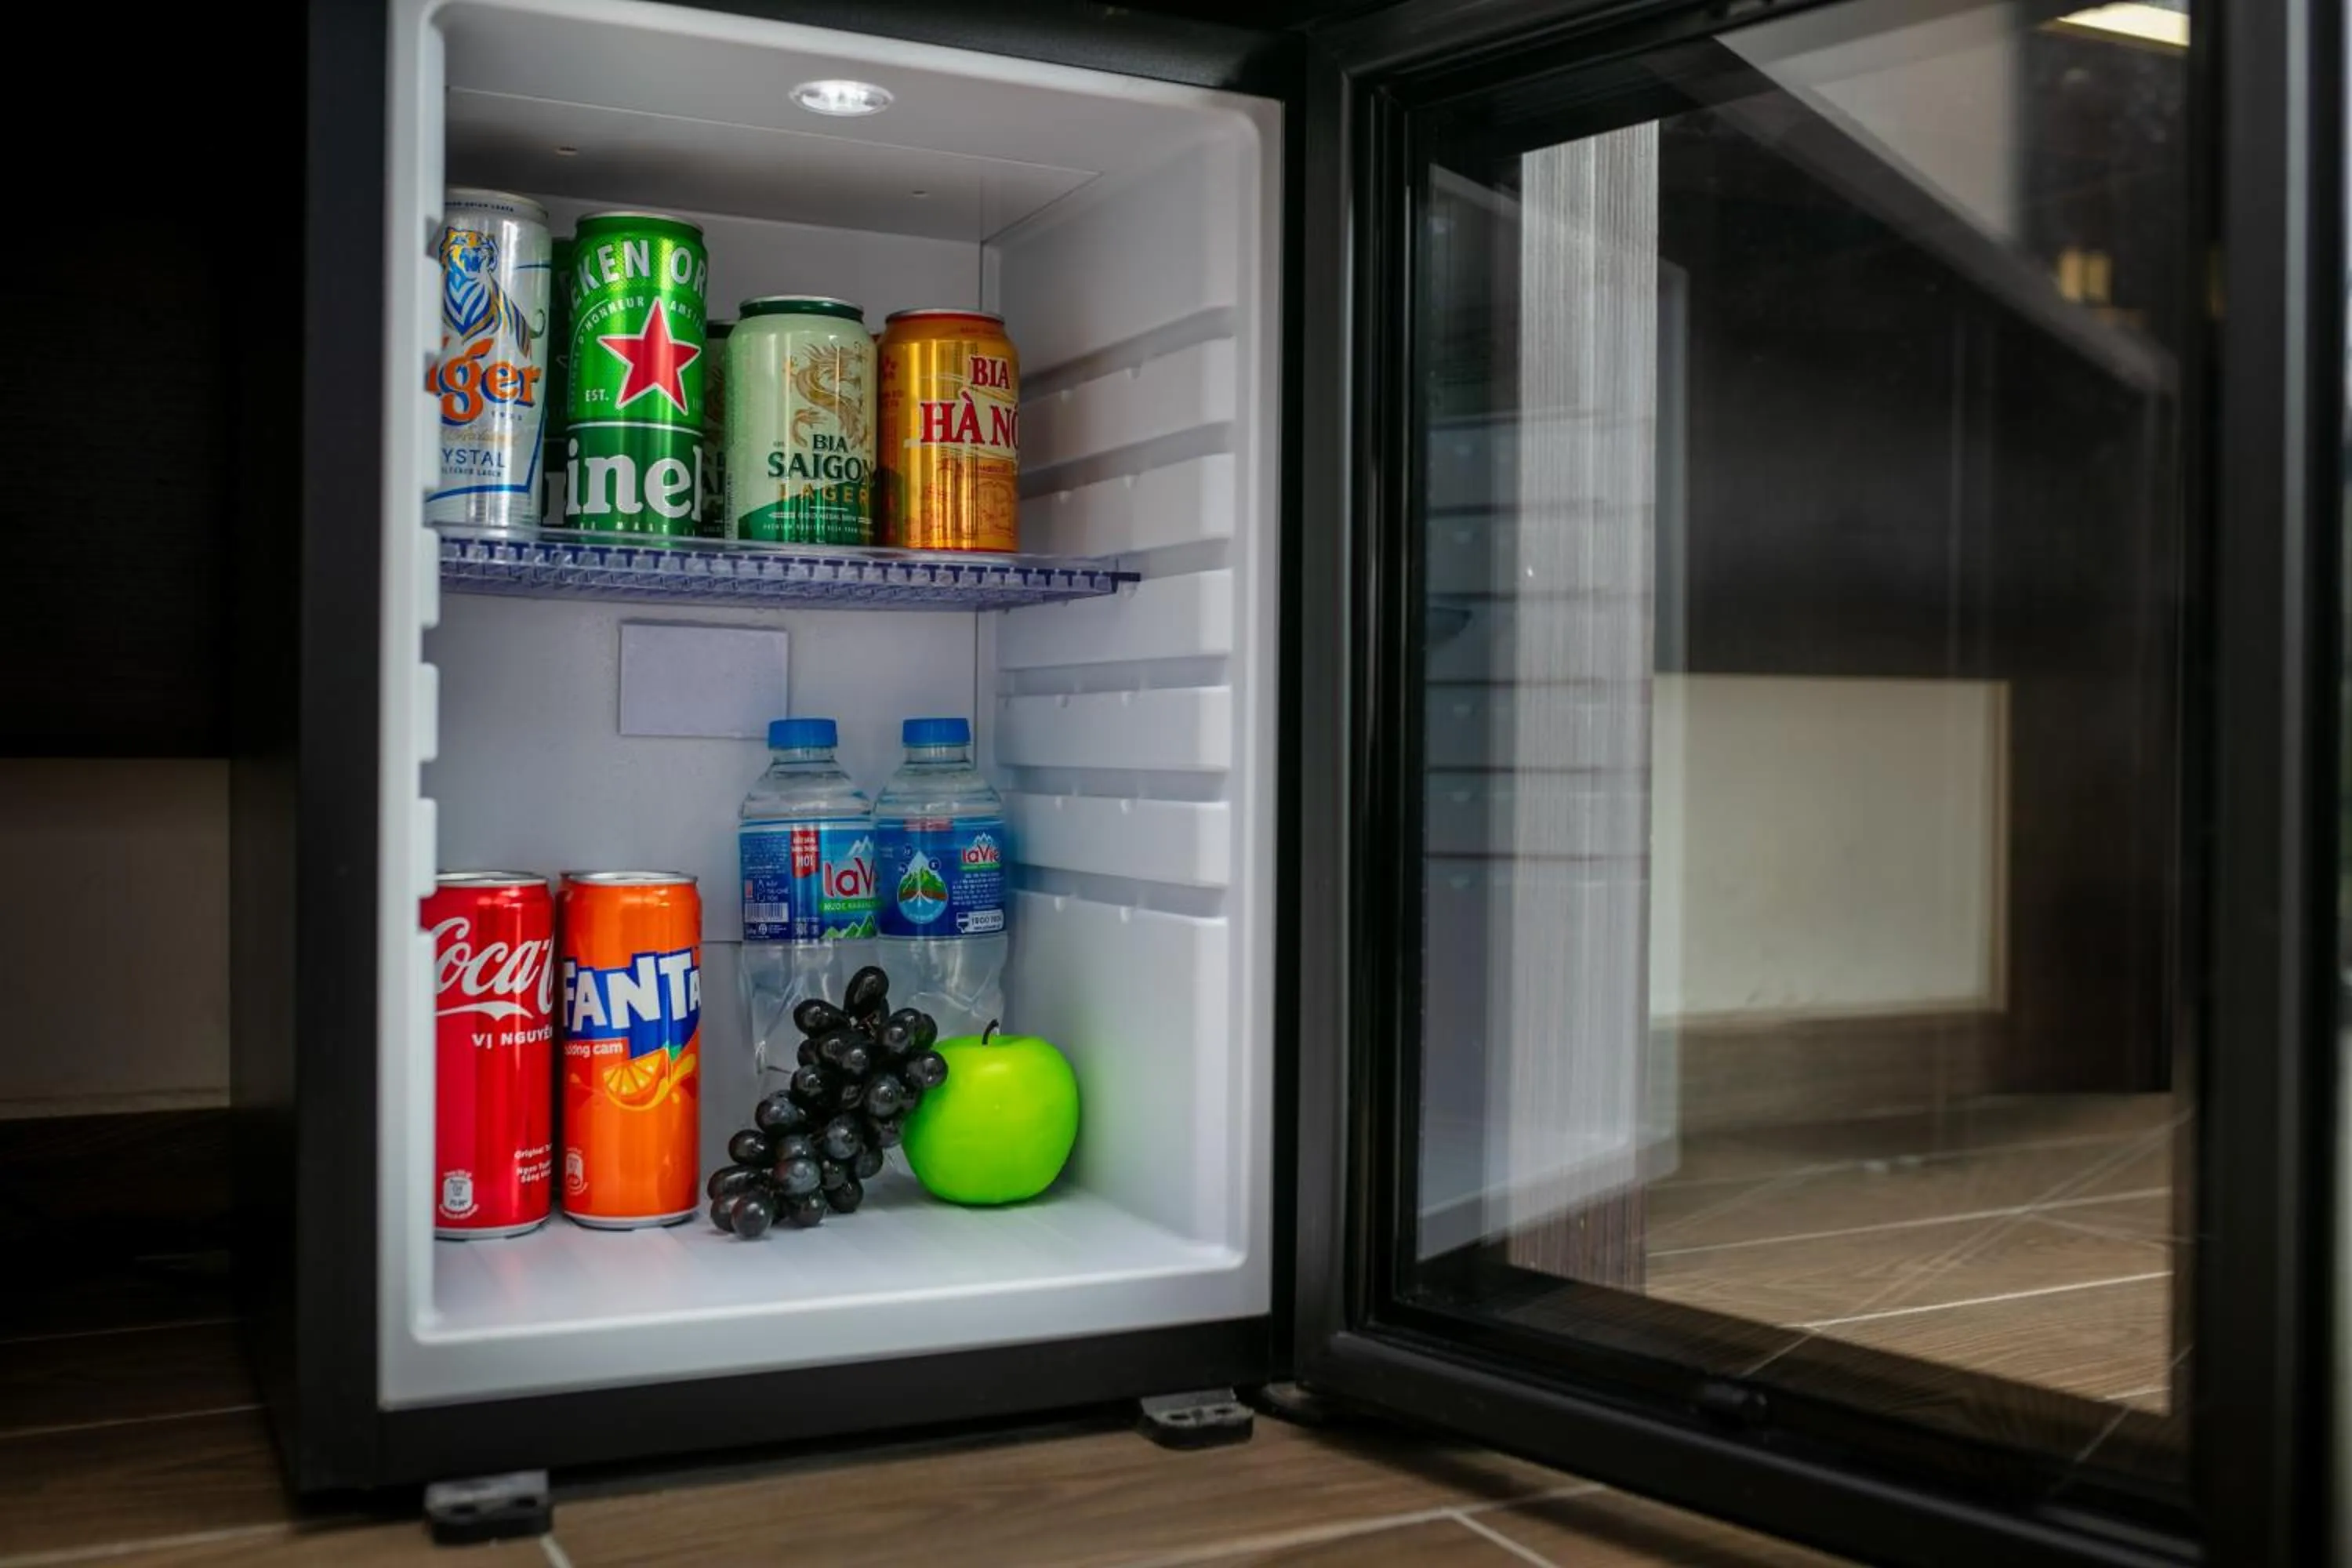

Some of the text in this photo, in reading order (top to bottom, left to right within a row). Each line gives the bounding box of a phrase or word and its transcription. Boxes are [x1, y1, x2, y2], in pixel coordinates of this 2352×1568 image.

[971, 356, 1011, 390] BIA
[586, 388, 609, 402] EST.
[920, 390, 985, 445] HÀ
[813, 434, 849, 453] BIA
[778, 483, 869, 506] LAGER
[564, 952, 701, 1033] FANTA
[471, 1033, 492, 1050] VỊ
[593, 1042, 624, 1055] cam
